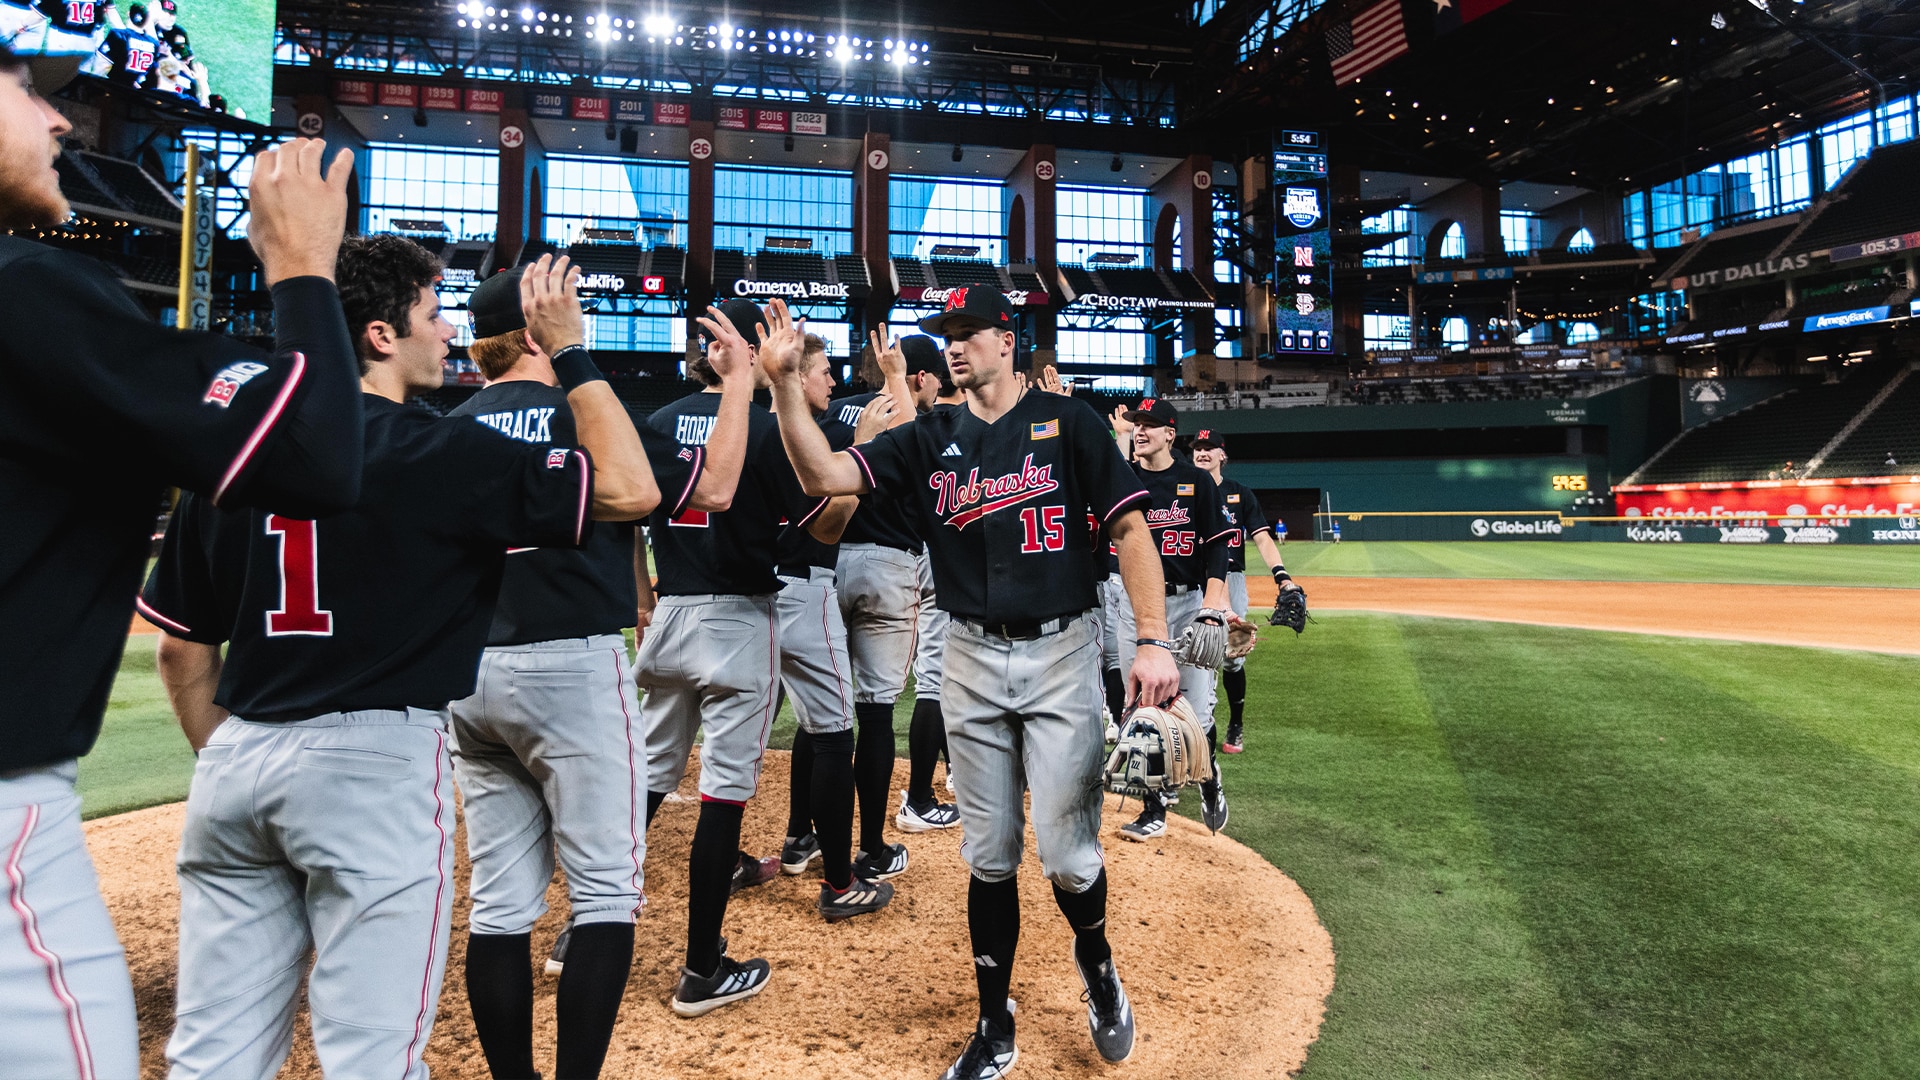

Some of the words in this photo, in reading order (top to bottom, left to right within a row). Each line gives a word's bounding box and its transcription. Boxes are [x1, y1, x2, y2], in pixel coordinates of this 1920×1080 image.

[69, 2, 95, 24] 14
[127, 50, 154, 72] 12
[472, 90, 498, 102] 2010
[536, 95, 562, 106] 2010
[579, 98, 602, 109] 2011
[620, 100, 642, 112] 2011
[660, 104, 685, 115] 2012
[720, 108, 744, 118] 2015
[760, 110, 783, 121] 2016
[796, 113, 822, 124] 2023
[301, 117, 320, 130] 42
[504, 130, 520, 144] 34
[1290, 134, 1312, 144] 5:54
[692, 143, 710, 154] 26
[874, 154, 882, 166] 7
[1038, 164, 1052, 176] 29
[1197, 174, 1208, 186] 10
[1860, 238, 1900, 256] 105.3
[1691, 270, 1719, 288] UT
[1724, 253, 1810, 282] DALLAS
[1296, 274, 1312, 284] VS
[810, 282, 850, 297] Bank
[946, 288, 969, 312] N
[1088, 294, 1158, 308] CHOCTAW
[1758, 320, 1790, 331] DISTANCE
[1285, 337, 1292, 347] 0
[1302, 338, 1309, 348] 0
[1320, 338, 1326, 348] 0
[1424, 348, 1452, 356] GOLD
[1470, 346, 1510, 354] HARGROVE
[929, 452, 1059, 516] Nebraska
[1019, 505, 1066, 554] 15
[1492, 520, 1534, 534] Globe
[1534, 520, 1562, 534] Life
[1626, 527, 1683, 542] Kubota
[1162, 530, 1196, 556] 25
[266, 514, 334, 636] 1
[1170, 726, 1182, 763] marucci
